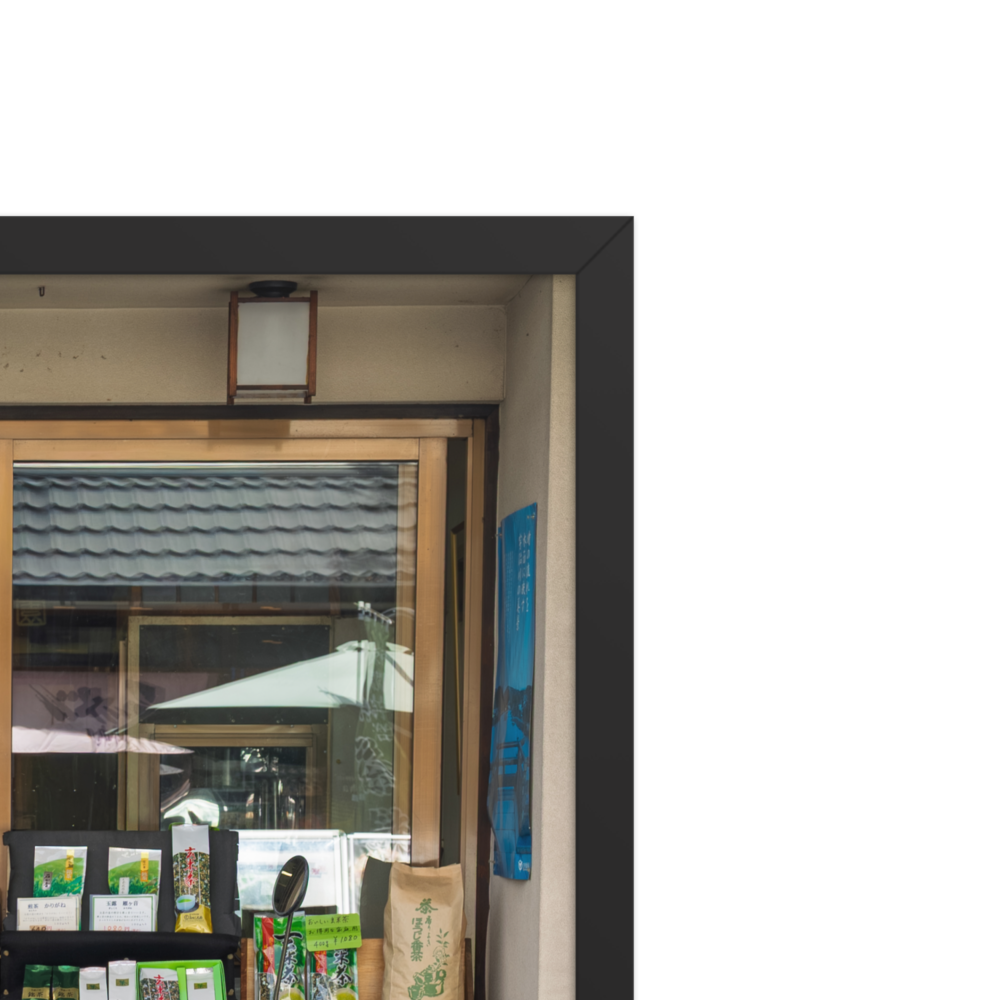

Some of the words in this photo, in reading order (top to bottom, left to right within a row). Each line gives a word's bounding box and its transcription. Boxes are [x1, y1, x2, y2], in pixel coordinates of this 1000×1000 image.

[184, 846, 198, 888] 玄米茶
[415, 898, 438, 914] 茶
